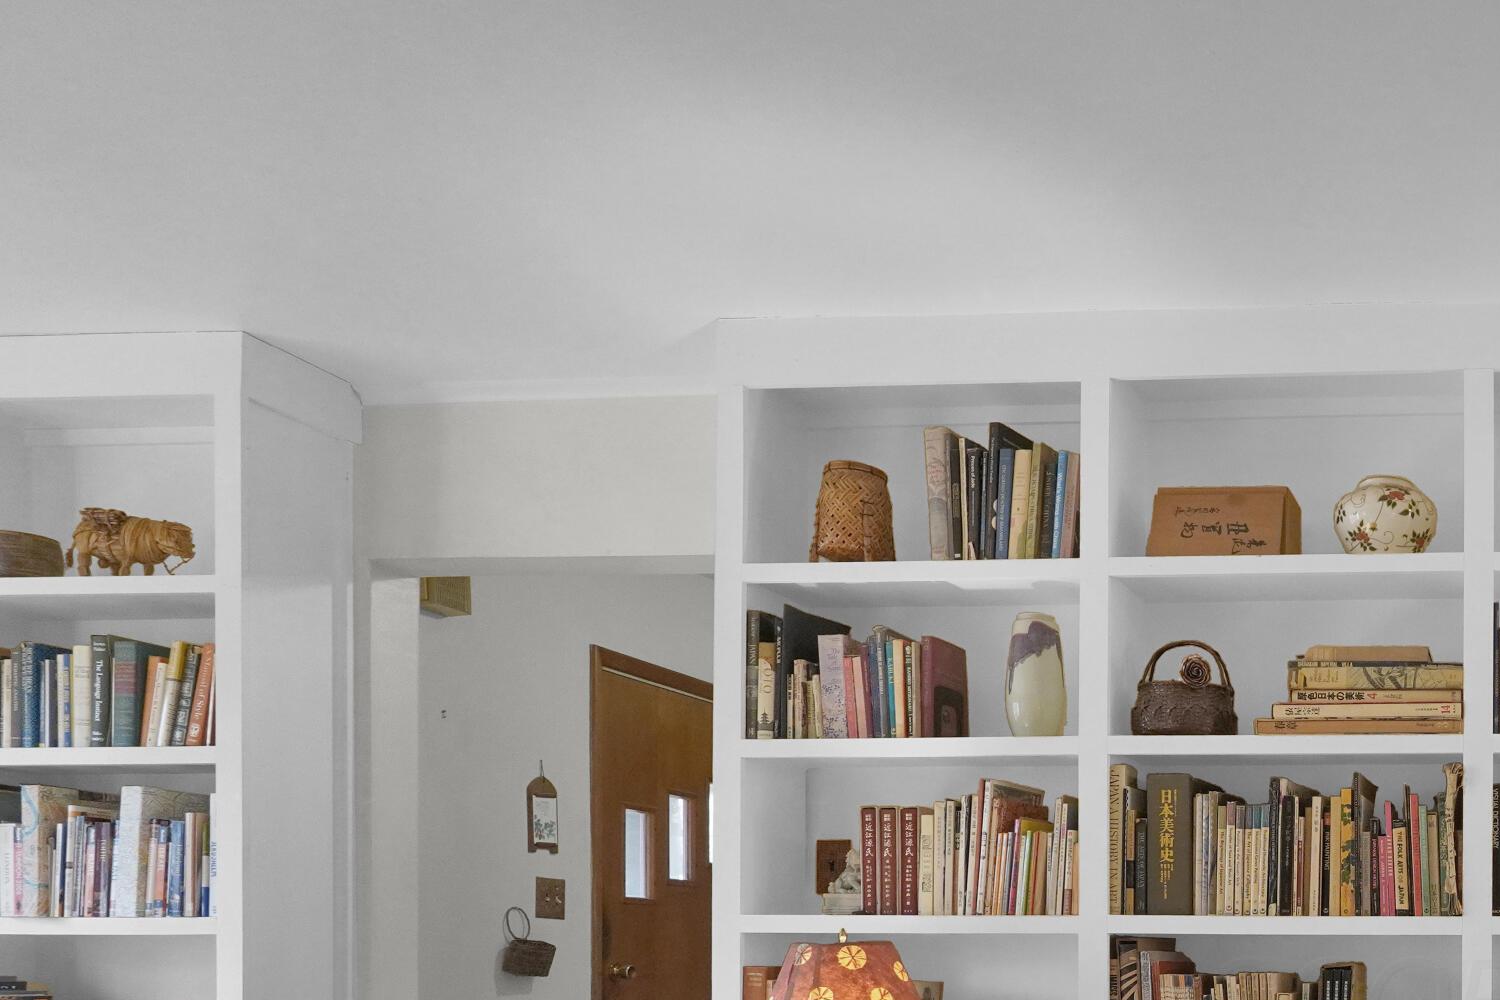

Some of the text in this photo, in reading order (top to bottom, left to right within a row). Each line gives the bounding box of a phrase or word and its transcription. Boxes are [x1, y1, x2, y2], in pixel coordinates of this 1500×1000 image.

[95, 673, 103, 699] Language
[194, 700, 204, 720] Style
[1441, 705, 1451, 714] 14
[1110, 770, 1119, 804] JAPAN
[1159, 789, 1175, 863] 日本美術史
[1110, 821, 1119, 863] HISTORY
[1110, 868, 1118, 878] IN
[1110, 975, 1118, 996] IMAGES
